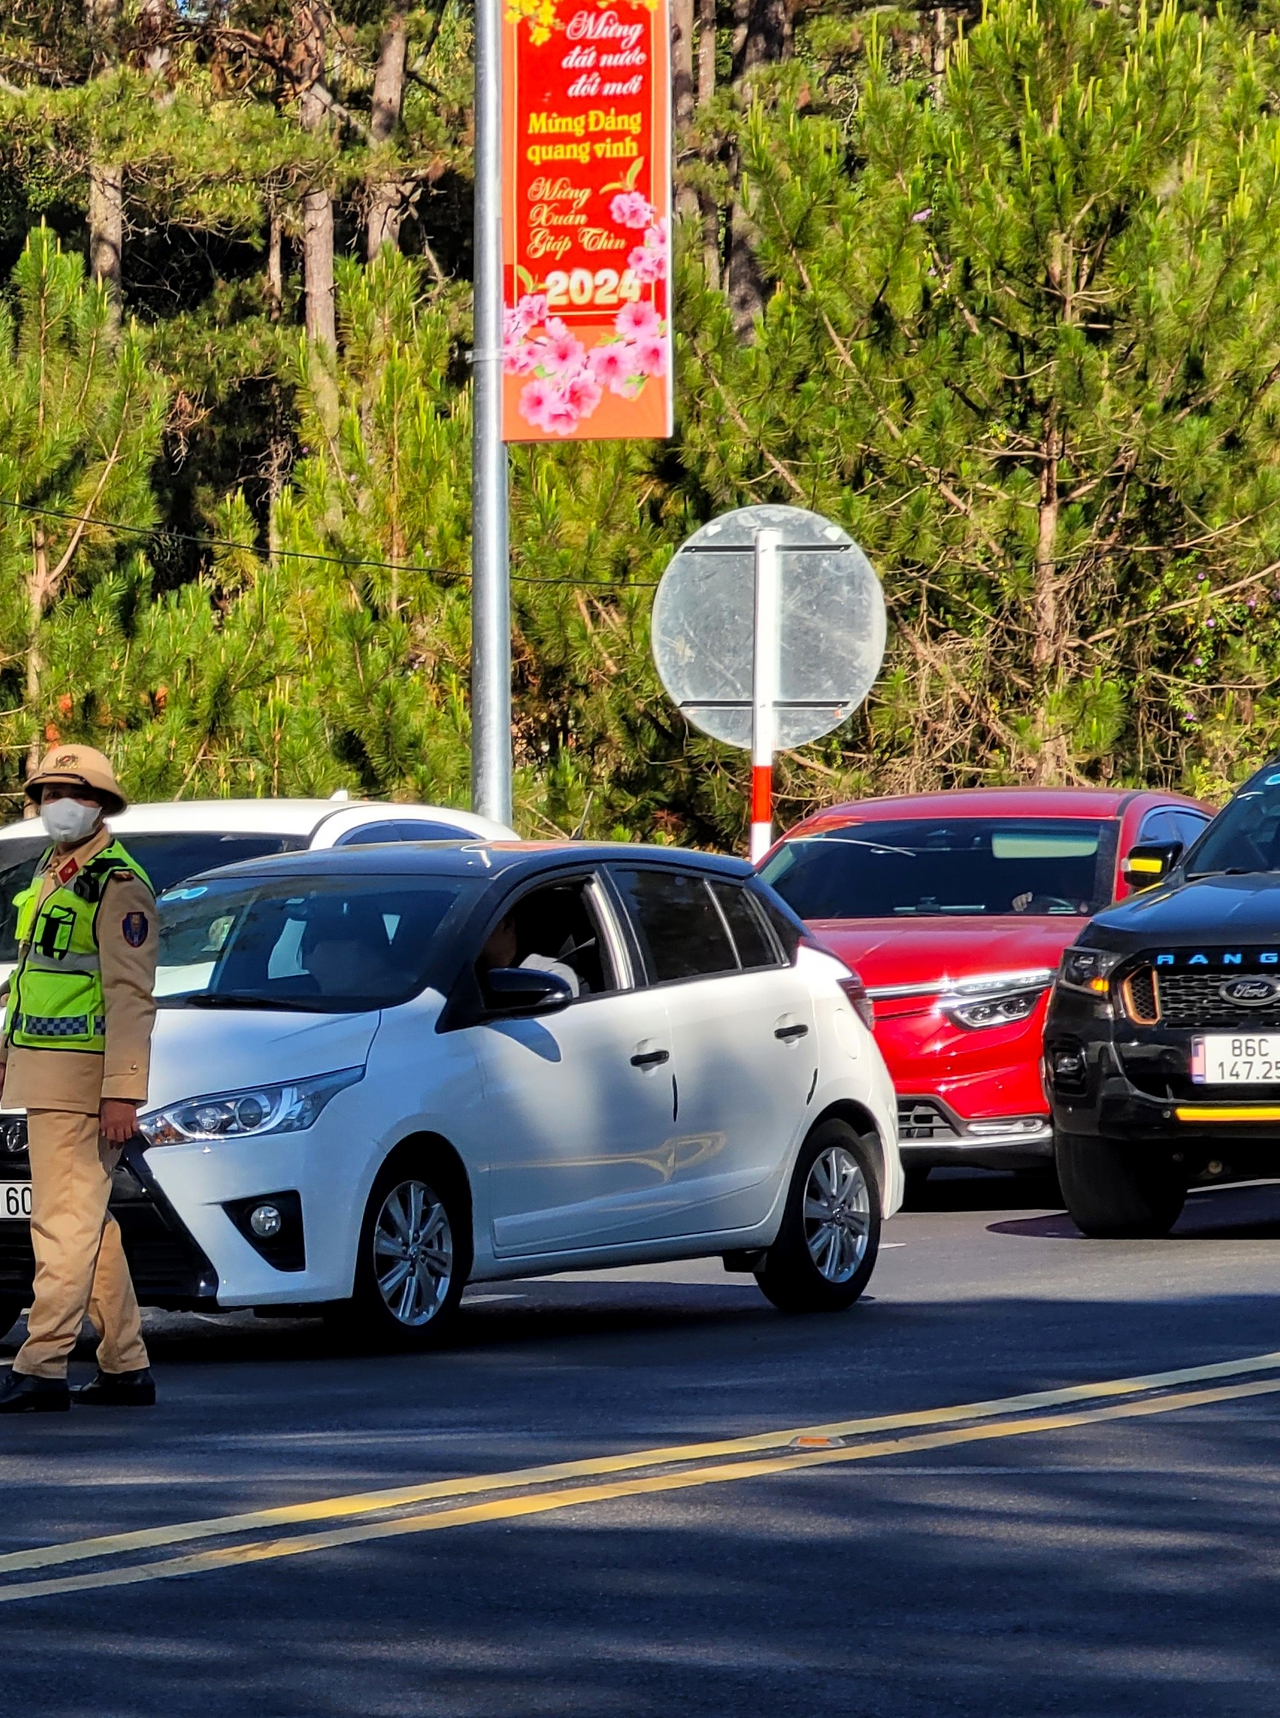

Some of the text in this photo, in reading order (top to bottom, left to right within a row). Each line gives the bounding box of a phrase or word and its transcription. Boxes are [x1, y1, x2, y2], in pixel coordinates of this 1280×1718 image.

[566, 10, 645, 50] Mừng
[561, 45, 648, 69] đất nước
[567, 72, 644, 98] đổi mới
[527, 107, 642, 137] Mừng Đảng
[526, 136, 639, 166] quang vinh
[527, 177, 592, 210] Mừng
[526, 226, 627, 261] Giáp Thìn
[545, 268, 641, 306] 2024
[1232, 981, 1270, 998] Ford
[1231, 1038, 1270, 1057] 86C
